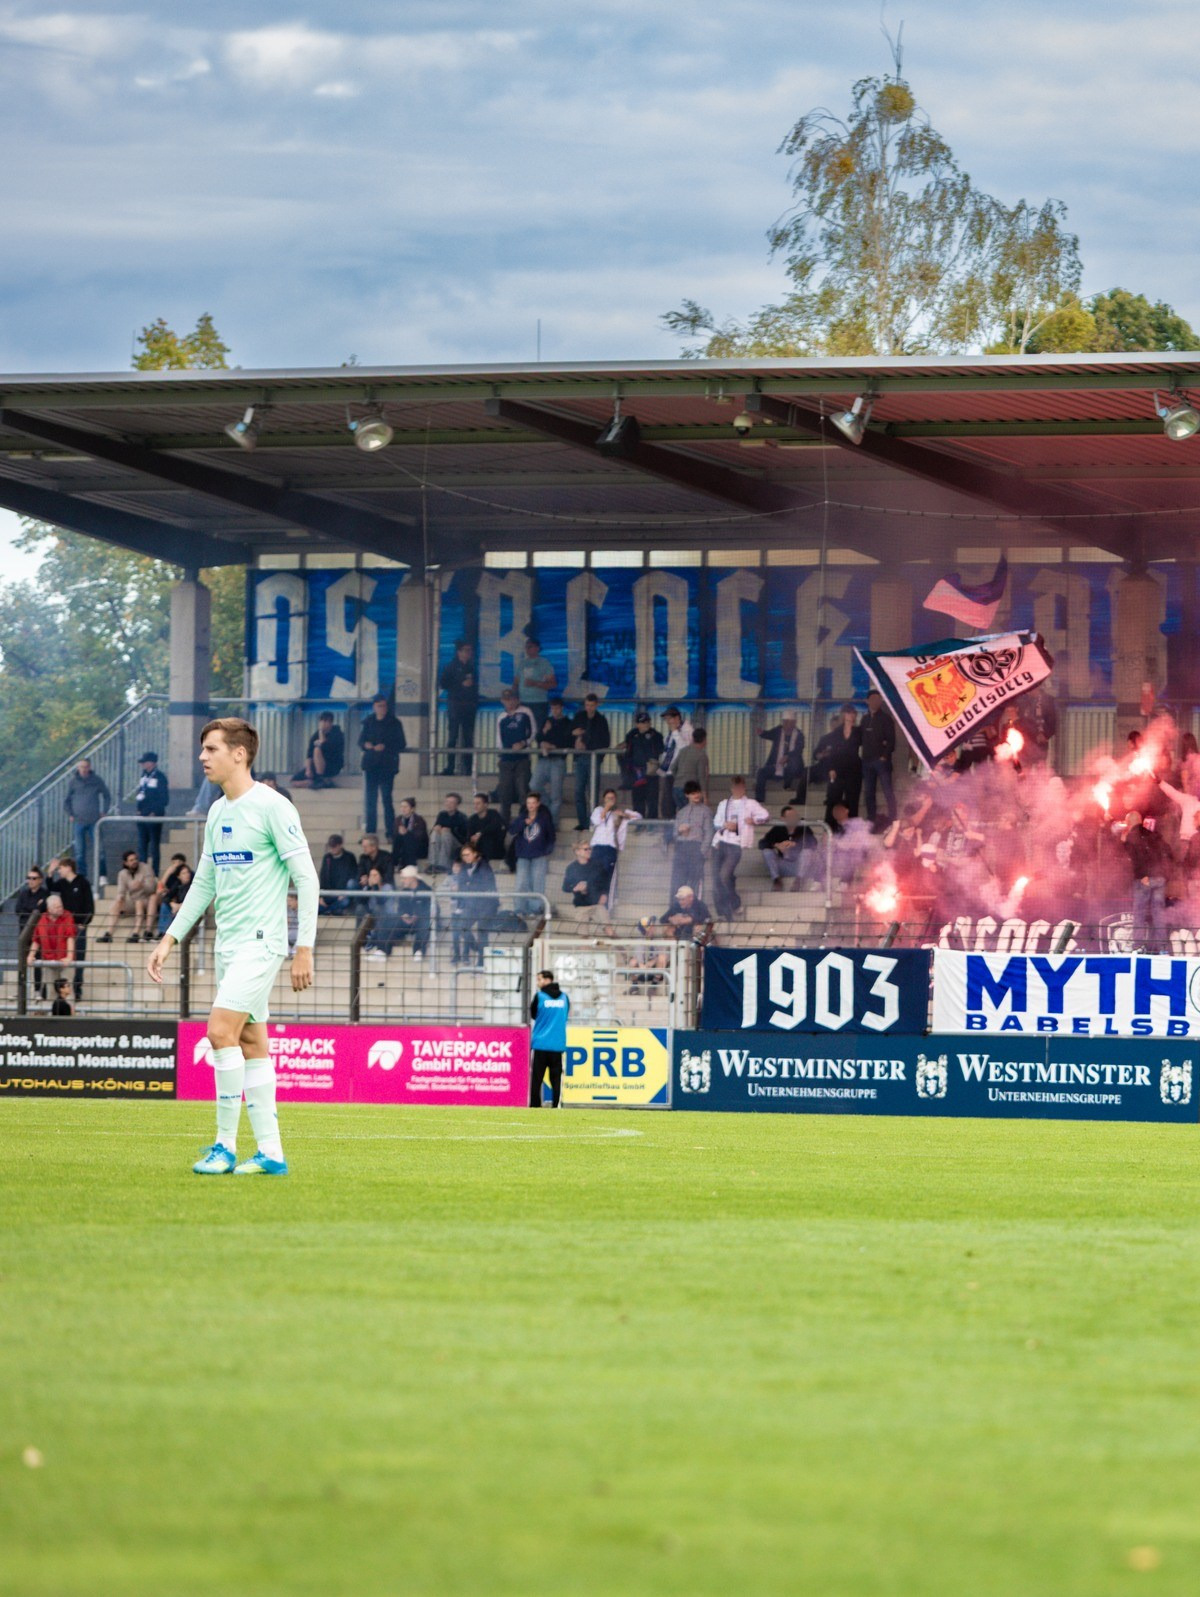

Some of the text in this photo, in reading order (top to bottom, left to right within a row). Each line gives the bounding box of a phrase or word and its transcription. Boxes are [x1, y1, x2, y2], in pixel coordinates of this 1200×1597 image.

[733, 951, 900, 1031] 1903
[0, 1033, 175, 1050] utos, Transporter & Roller
[268, 1037, 336, 1055] ERPACK
[411, 1040, 513, 1057] TAVERPACK
[7, 1052, 75, 1067] kleinsten
[77, 1053, 175, 1069] Monatsraten!
[279, 1055, 335, 1071] Potsdam
[411, 1058, 511, 1073] GmbH Potsdam
[565, 1046, 646, 1077] PRB
[0, 1078, 174, 1092] UTOHAUS-KÖNIG.DE
